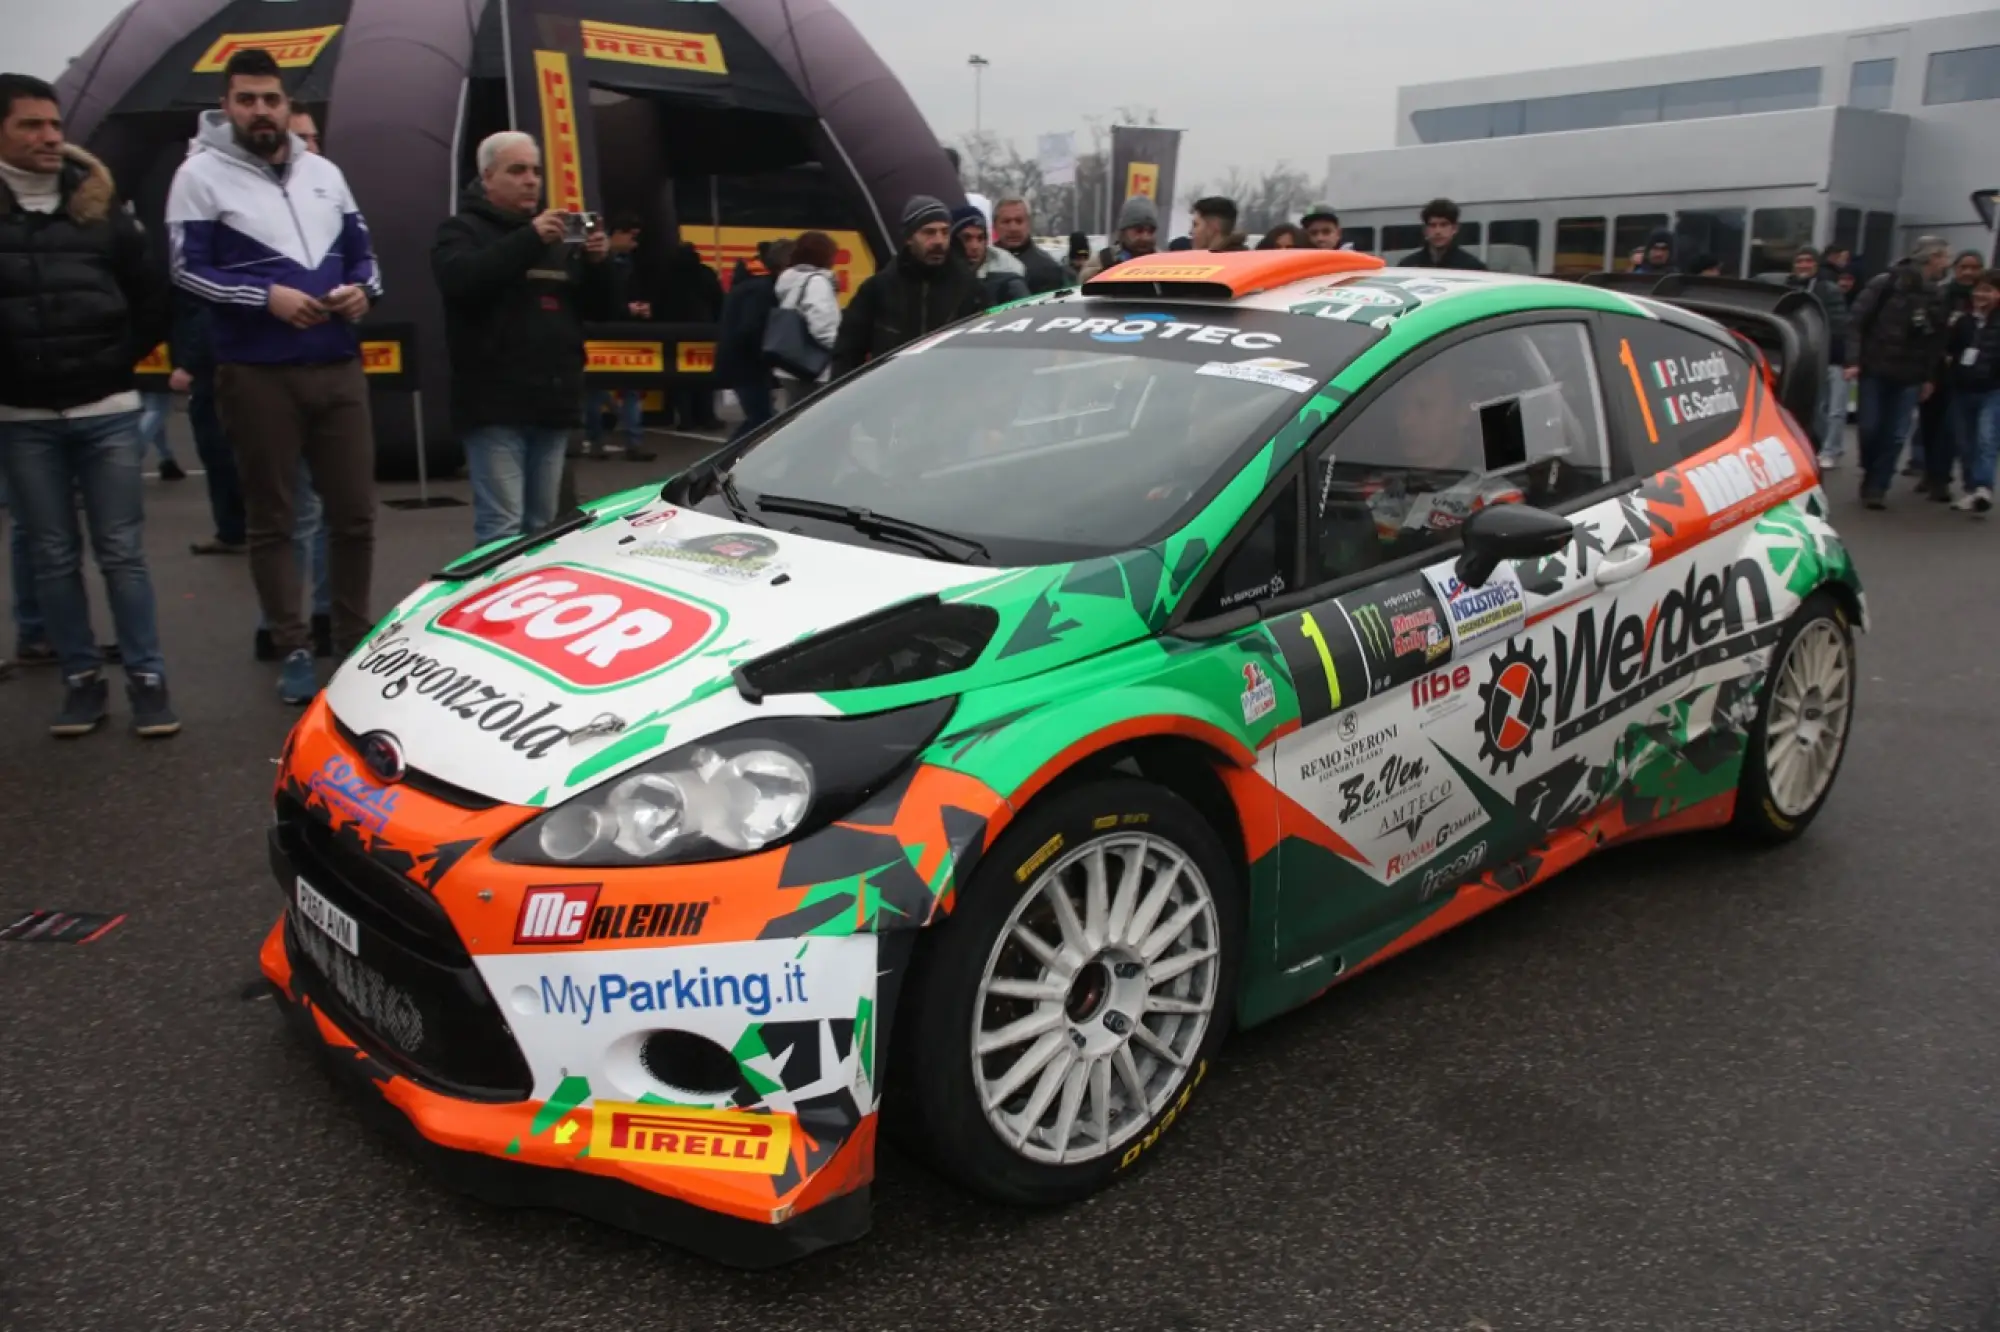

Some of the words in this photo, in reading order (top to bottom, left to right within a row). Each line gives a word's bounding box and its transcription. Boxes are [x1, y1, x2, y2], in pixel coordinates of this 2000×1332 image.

[1036, 317, 1283, 350] PROTEC
[461, 576, 672, 668] IGOR
[1450, 580, 1520, 622] INDUSTRIES
[1299, 611, 1341, 710] 1
[1552, 557, 1774, 728] Werden
[357, 637, 572, 760] Gorgonzola
[1411, 665, 1470, 711] libe
[1300, 750, 1341, 780] REMO
[1343, 724, 1398, 761] SPERONI
[1379, 778, 1453, 833] AMTECO
[540, 964, 808, 1024] MyParking.it
[610, 1113, 773, 1161] PIRELLI
